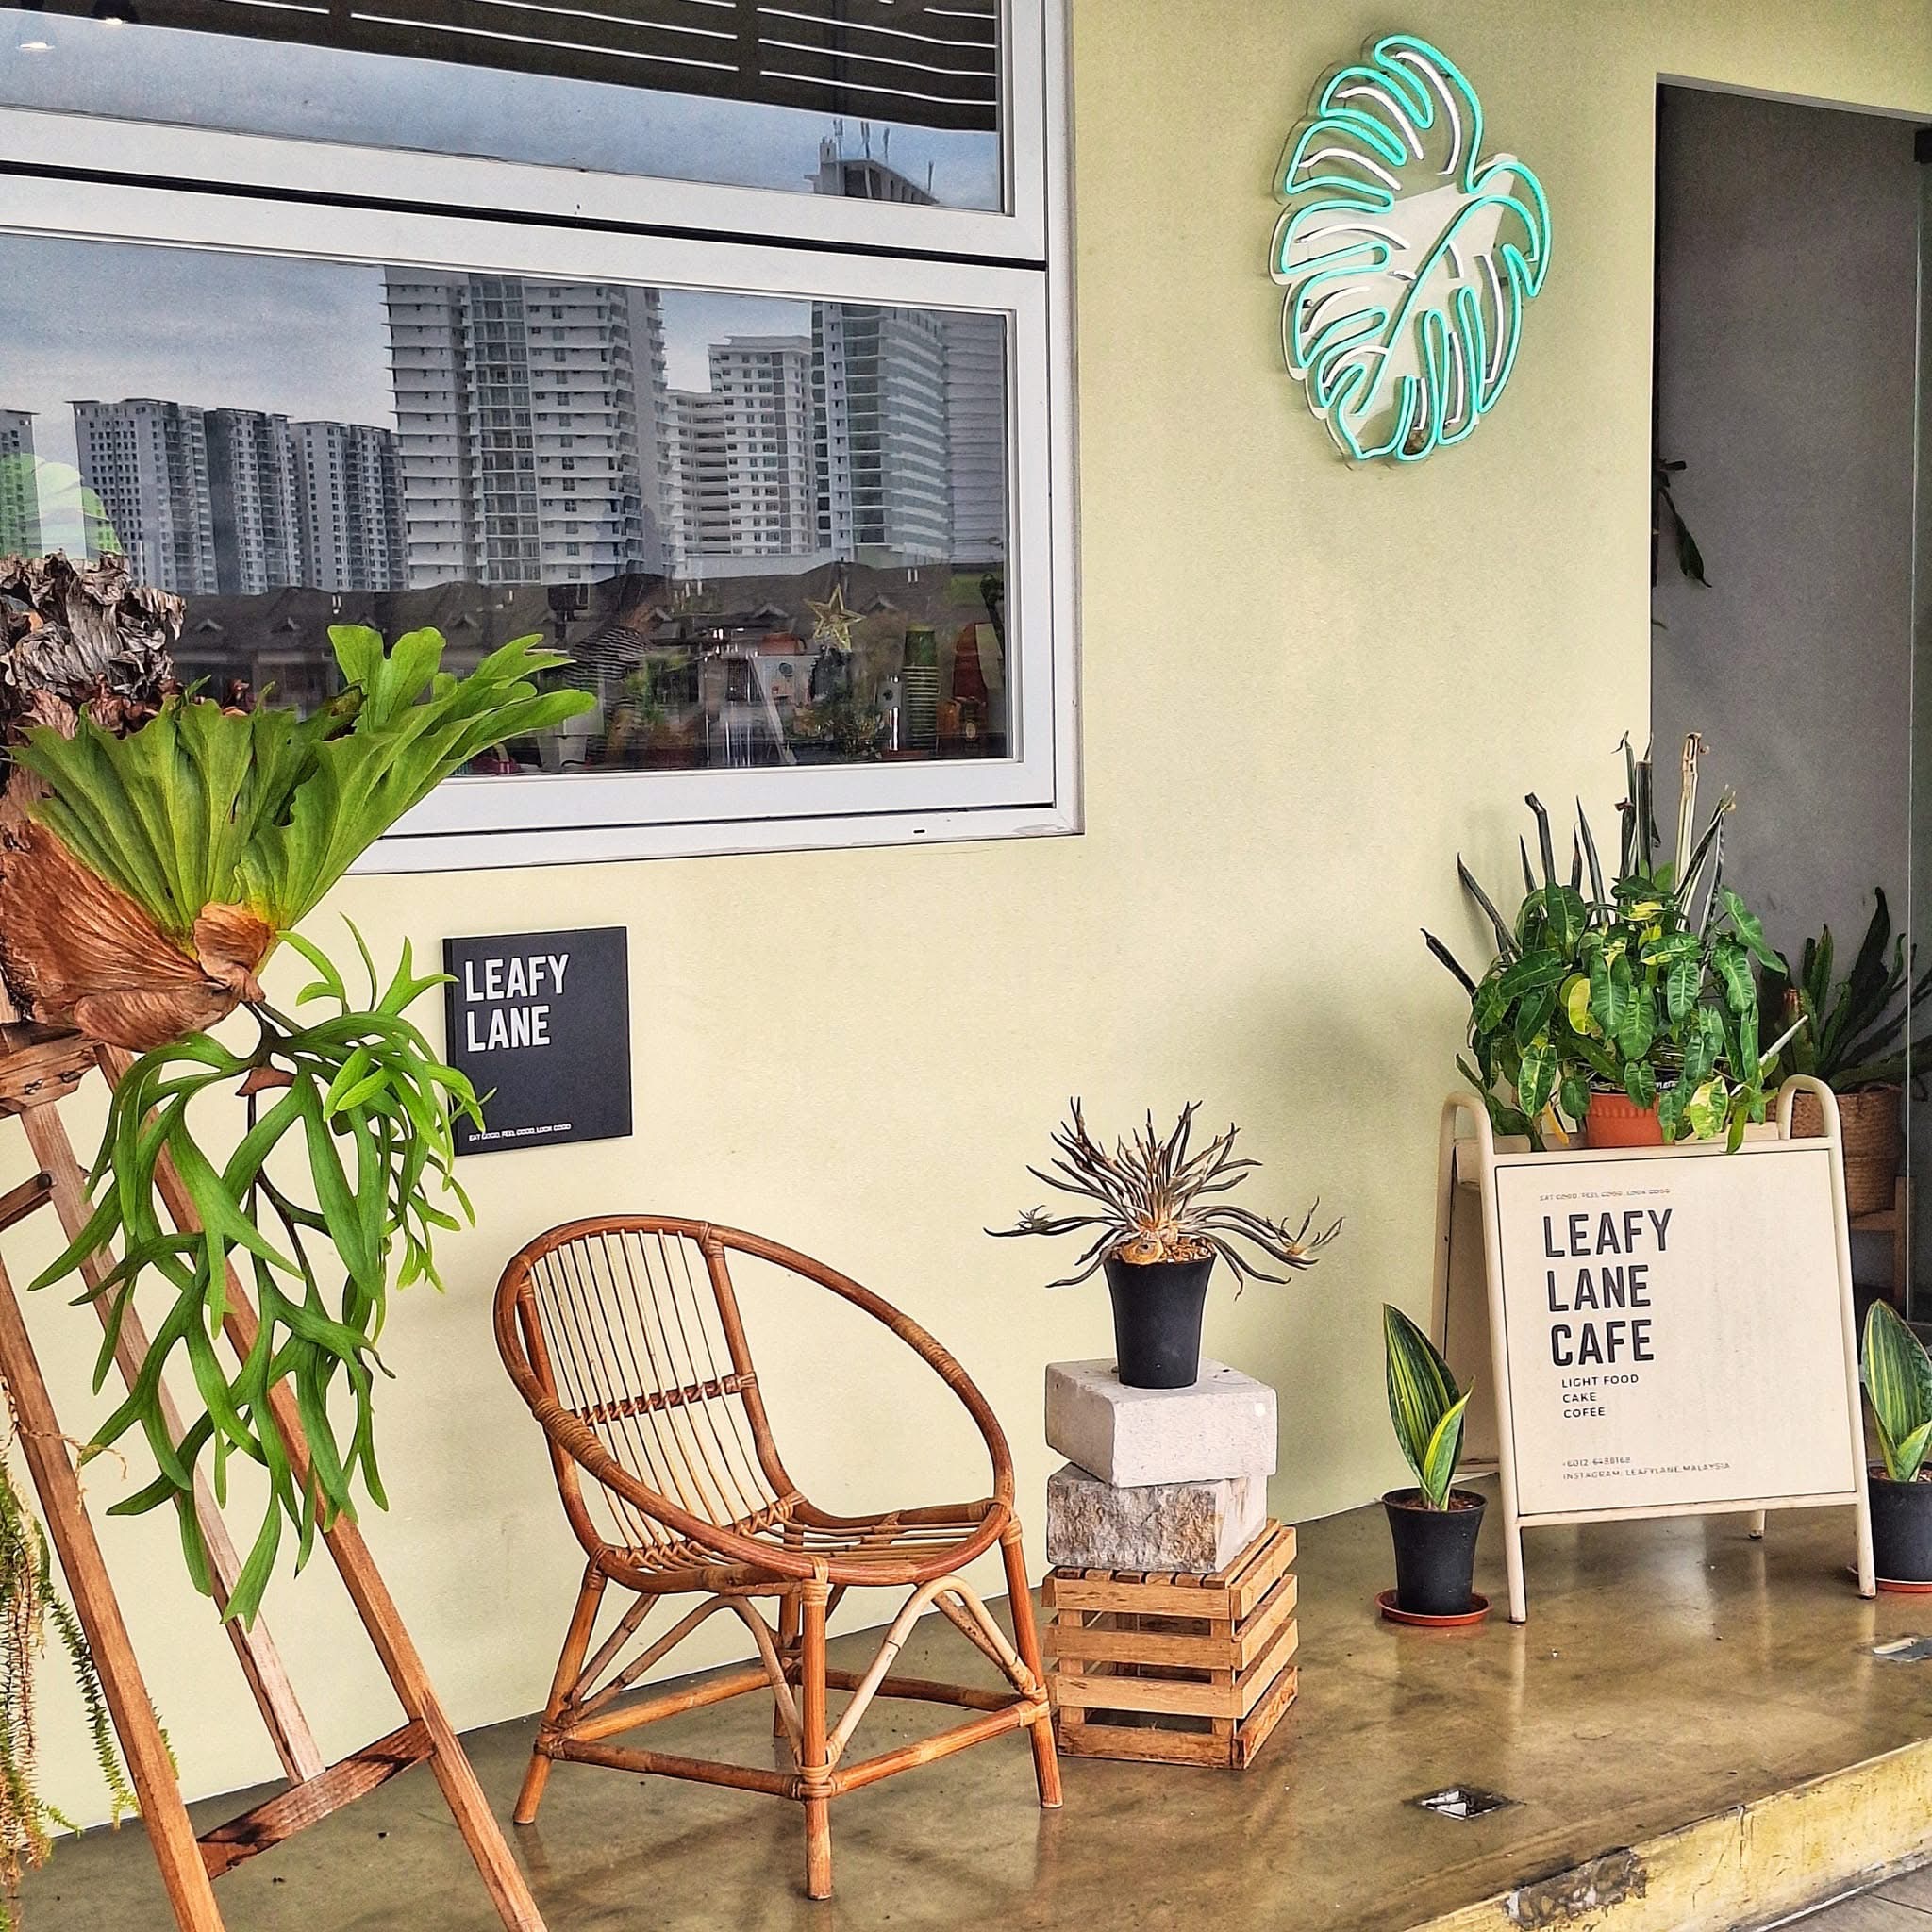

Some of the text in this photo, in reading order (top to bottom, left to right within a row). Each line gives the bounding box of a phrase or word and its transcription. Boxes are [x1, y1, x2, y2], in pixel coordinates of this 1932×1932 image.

[465, 954, 569, 1002] LEAFY
[467, 1005, 551, 1052] LANE
[1542, 1208, 1673, 1258] LEAFY
[1546, 1264, 1651, 1312] LANE
[1550, 1319, 1654, 1367] CAFE
[1561, 1374, 1639, 1388] LIGHT FOOD
[1562, 1391, 1597, 1404] CAKE
[1563, 1407, 1606, 1419] COFEE
